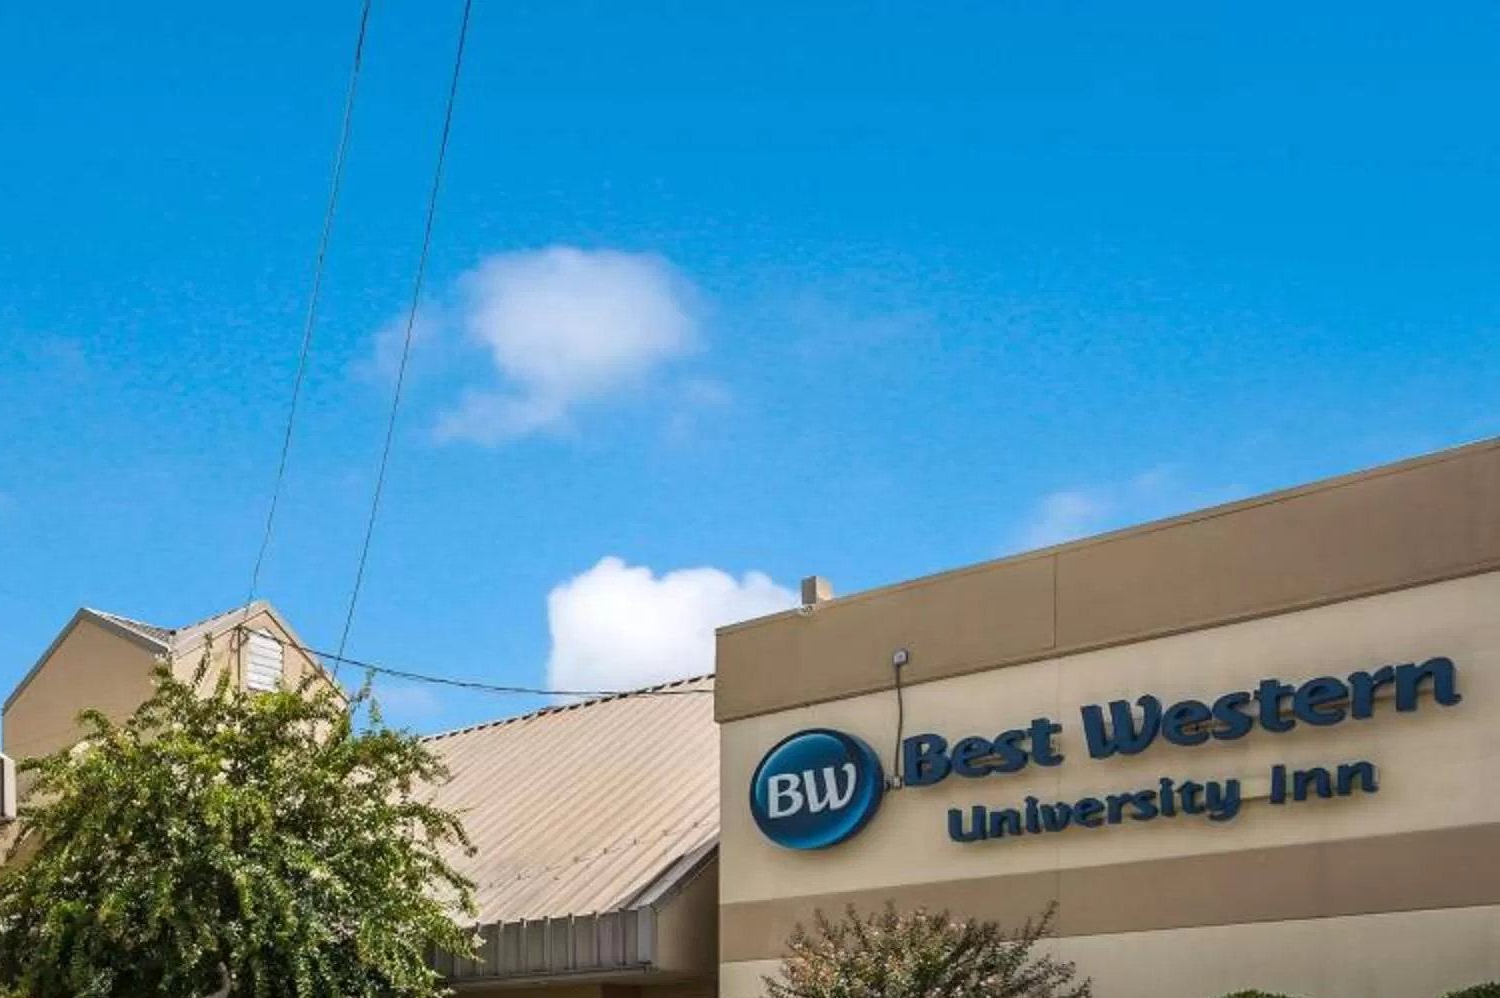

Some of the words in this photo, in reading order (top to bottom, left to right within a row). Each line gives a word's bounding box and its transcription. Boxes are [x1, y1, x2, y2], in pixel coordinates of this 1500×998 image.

[903, 717, 1065, 786] Best
[1080, 656, 1462, 759] Western
[767, 763, 857, 818] BW
[948, 776, 1242, 842] University
[1269, 760, 1380, 804] Inn
